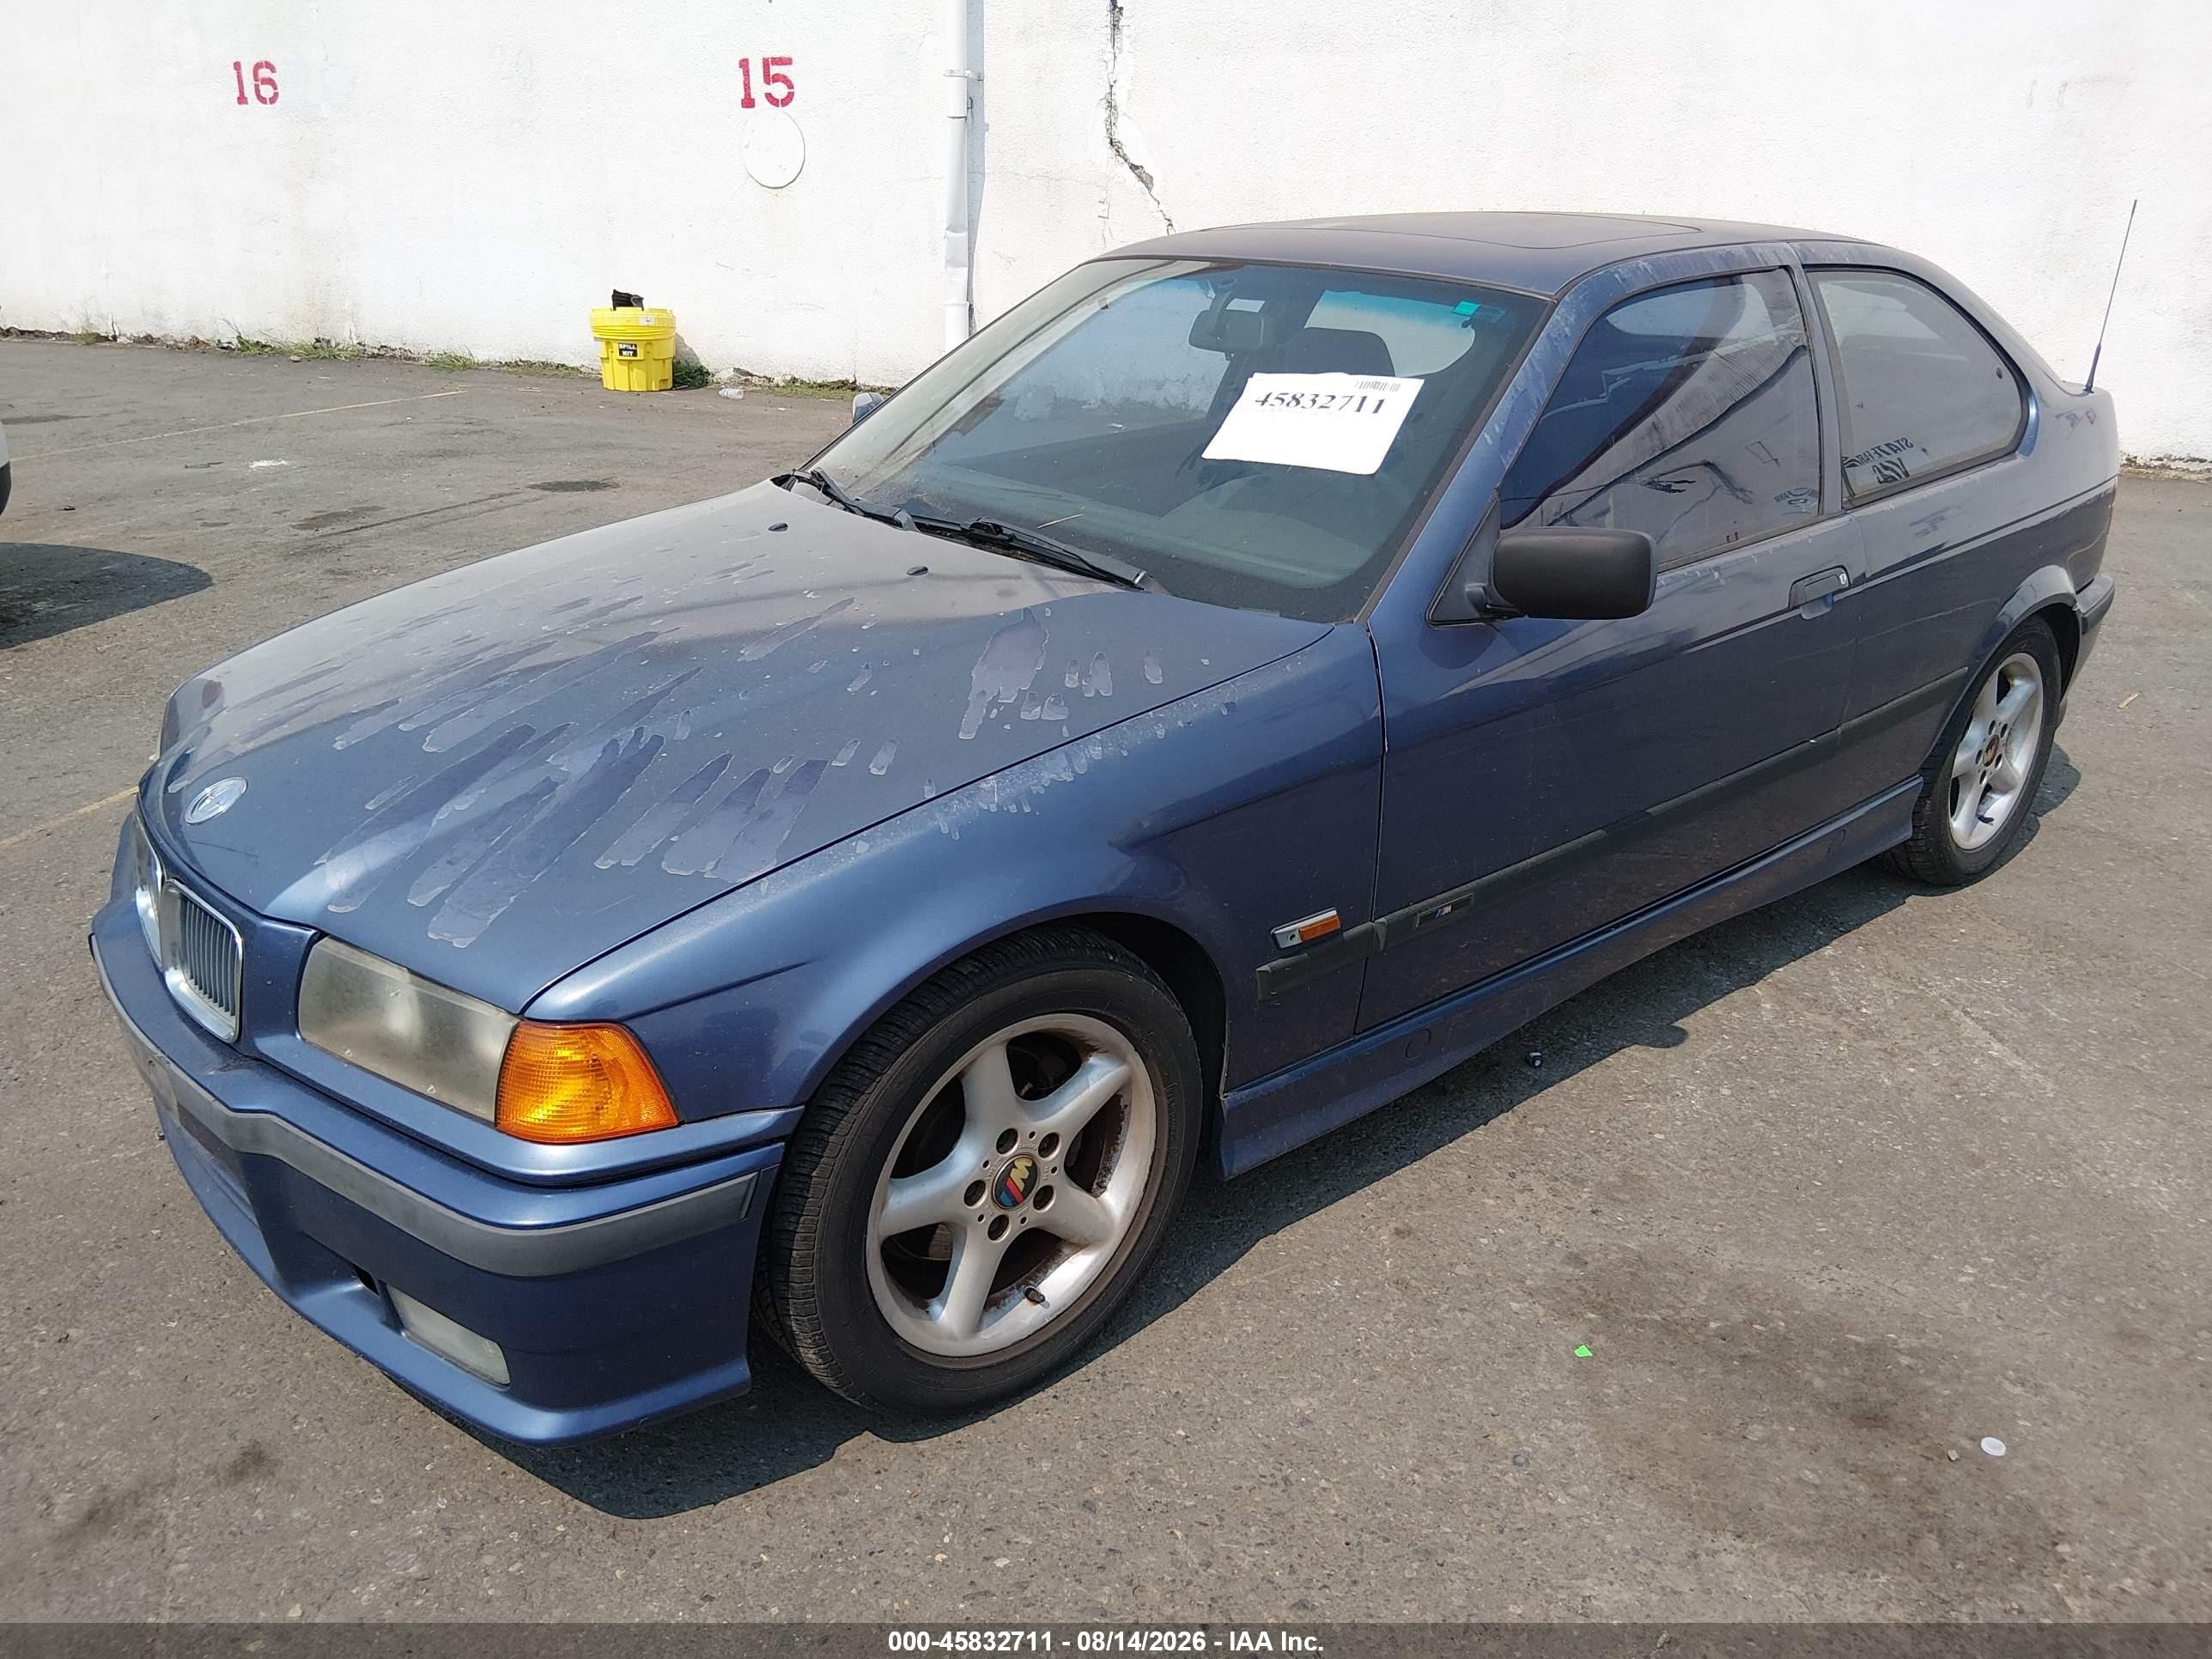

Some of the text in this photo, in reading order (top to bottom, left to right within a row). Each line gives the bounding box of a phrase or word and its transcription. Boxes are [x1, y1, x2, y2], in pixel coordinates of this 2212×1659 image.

[234, 60, 279, 105] 16
[738, 57, 794, 108] 15
[1255, 392, 1385, 414] 45832711
